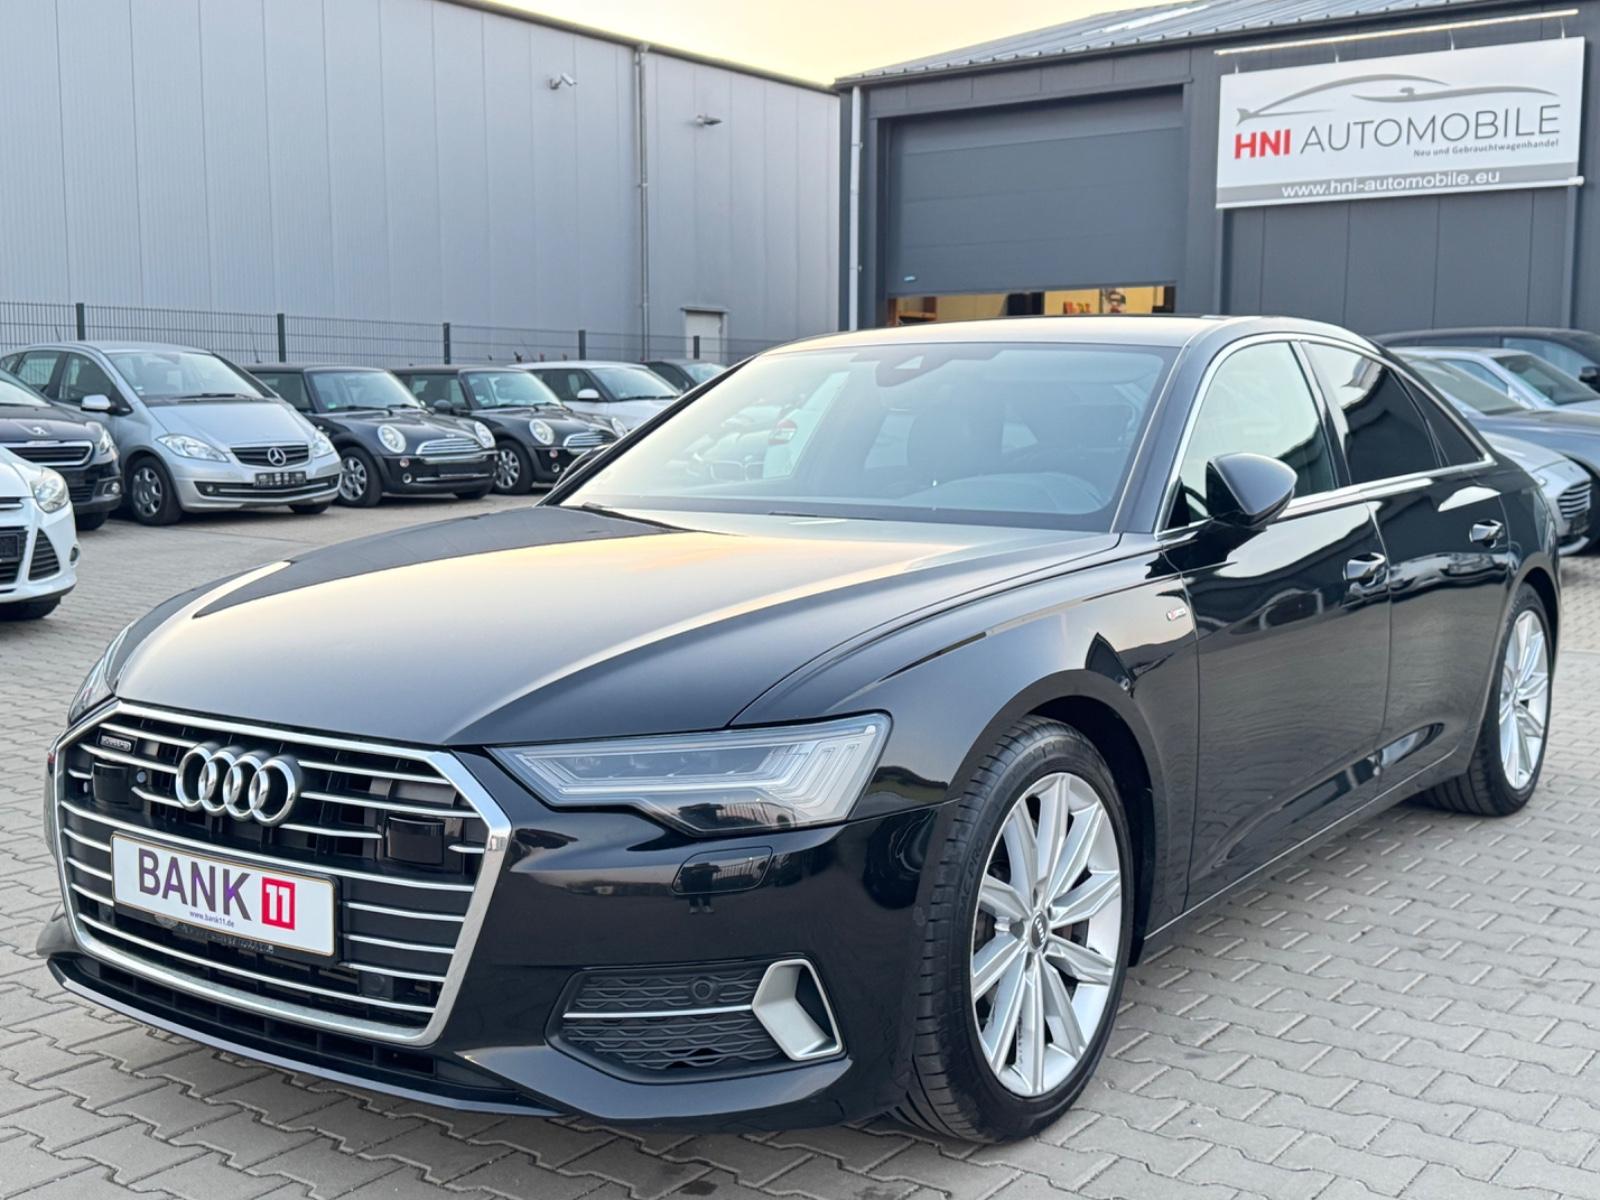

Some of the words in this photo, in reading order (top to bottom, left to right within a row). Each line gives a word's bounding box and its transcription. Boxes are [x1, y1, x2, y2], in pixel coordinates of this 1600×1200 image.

[1234, 128, 1291, 160] HNI
[1300, 104, 1561, 154] AUTOMOBILE
[1413, 149, 1431, 157] Neu
[1433, 148, 1449, 156] und
[1452, 139, 1559, 155] Gebrauchtwagenhandel
[1281, 170, 1500, 198] www.hni-automobile.eu
[138, 847, 252, 921] BANK
[266, 882, 291, 923] 11
[189, 911, 235, 928] www.bank11.de
